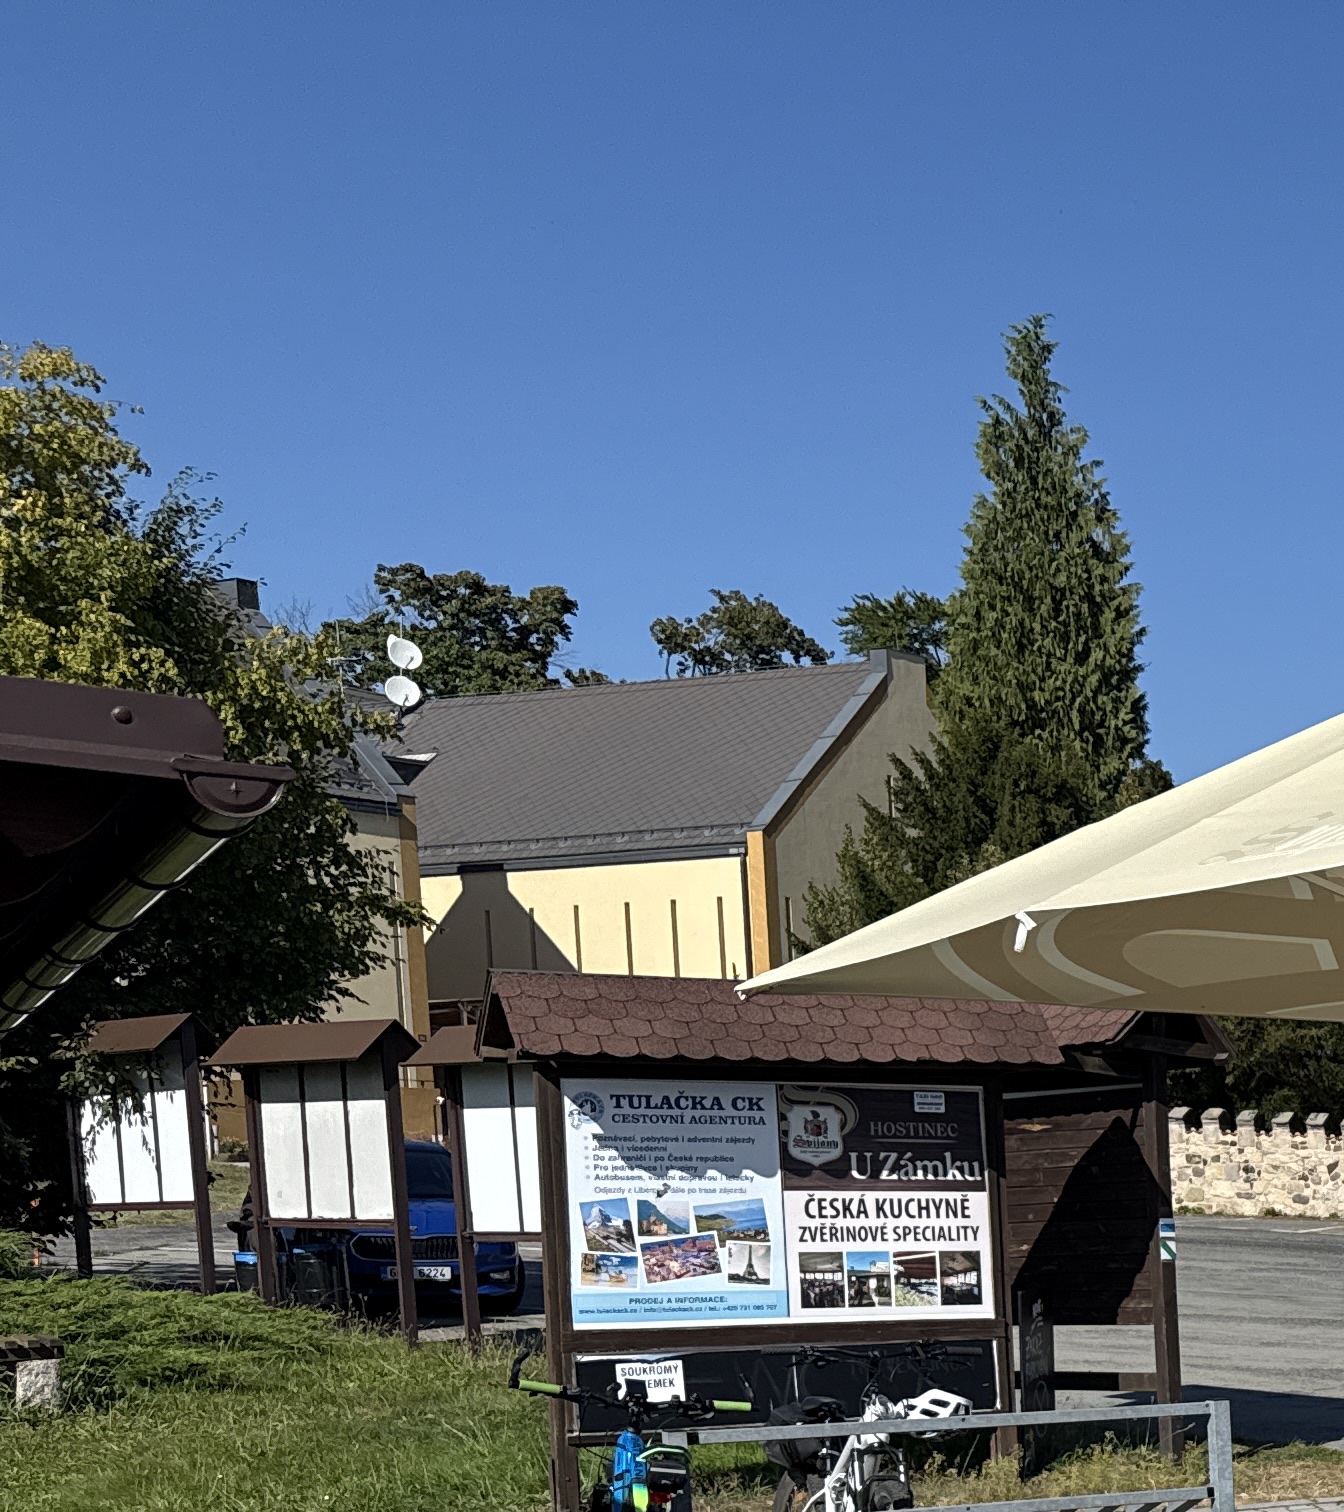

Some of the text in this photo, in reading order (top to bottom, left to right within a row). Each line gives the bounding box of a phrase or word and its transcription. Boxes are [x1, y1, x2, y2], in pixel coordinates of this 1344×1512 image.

[610, 1091, 725, 1111] TULAČKA
[731, 1096, 765, 1111] CK
[611, 1112, 766, 1125] CESTOVNÍ AGENTURA
[870, 1121, 958, 1137] HOSTINEC
[793, 1135, 838, 1149] Svijany
[849, 1151, 982, 1181] U Zámku
[804, 1193, 971, 1219] ČESKÁ KUCHYNĚ
[798, 1222, 980, 1243] ZVĚŘINOVÉ SPECIALITY
[620, 1362, 679, 1377] SOUKROMÝ
